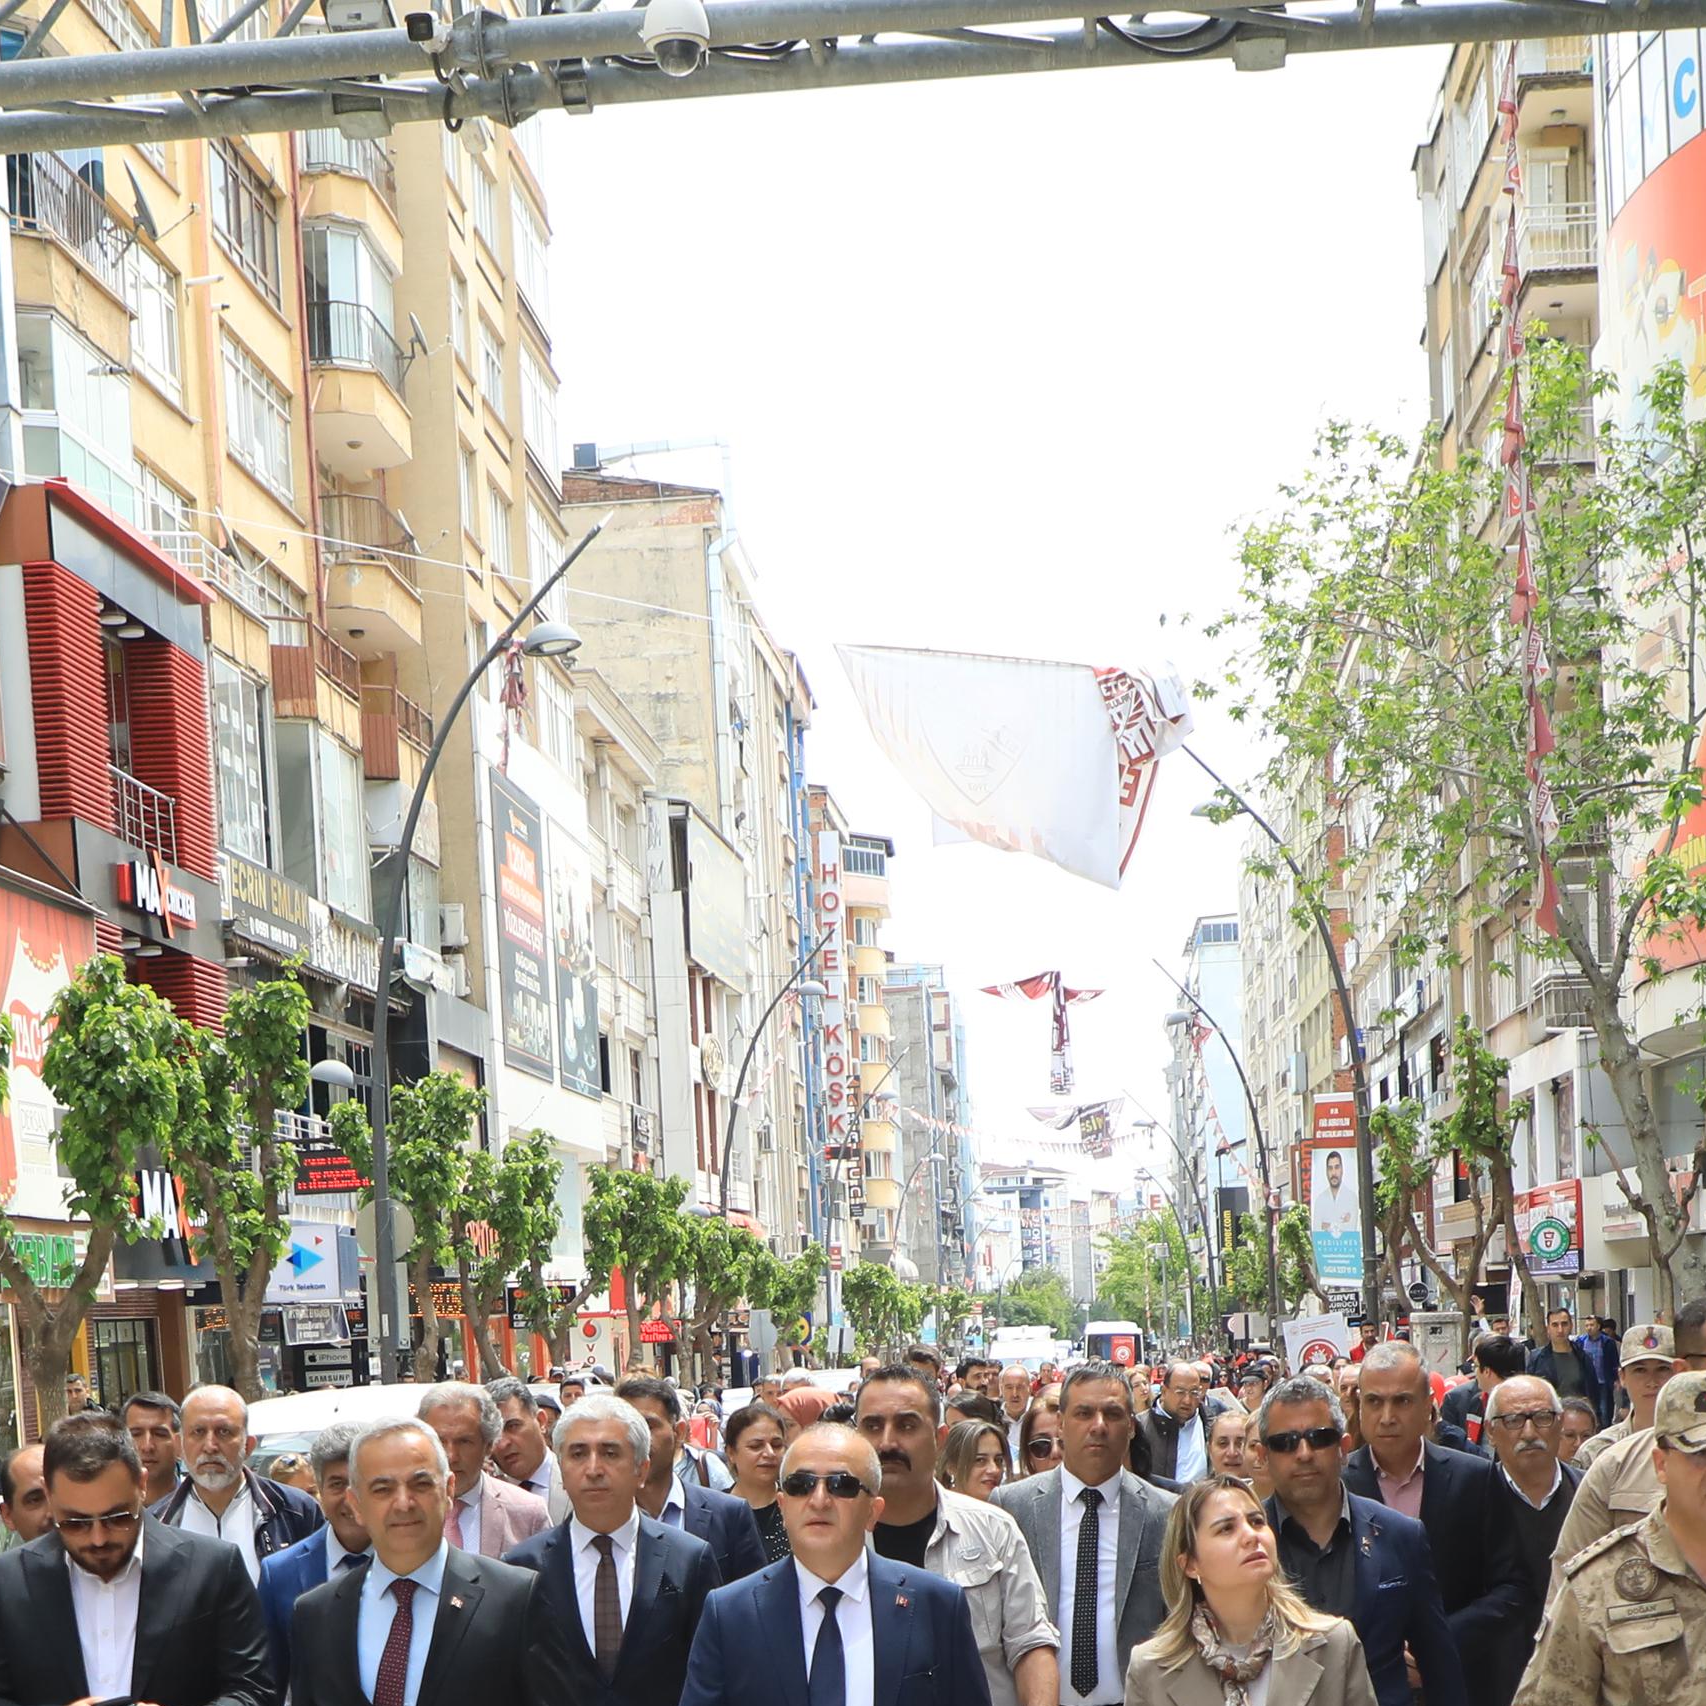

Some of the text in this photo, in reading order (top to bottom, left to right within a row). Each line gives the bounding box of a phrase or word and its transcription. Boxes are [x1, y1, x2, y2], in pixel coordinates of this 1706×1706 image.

[231, 858, 267, 910] ECRİN
[167, 889, 196, 922] CHICKEN
[821, 863, 841, 1000] HOTEL
[825, 1024, 847, 1135] KÖŞK
[296, 1283, 326, 1291] Telekom
[1627, 1603, 1657, 1616] DOĞAN
